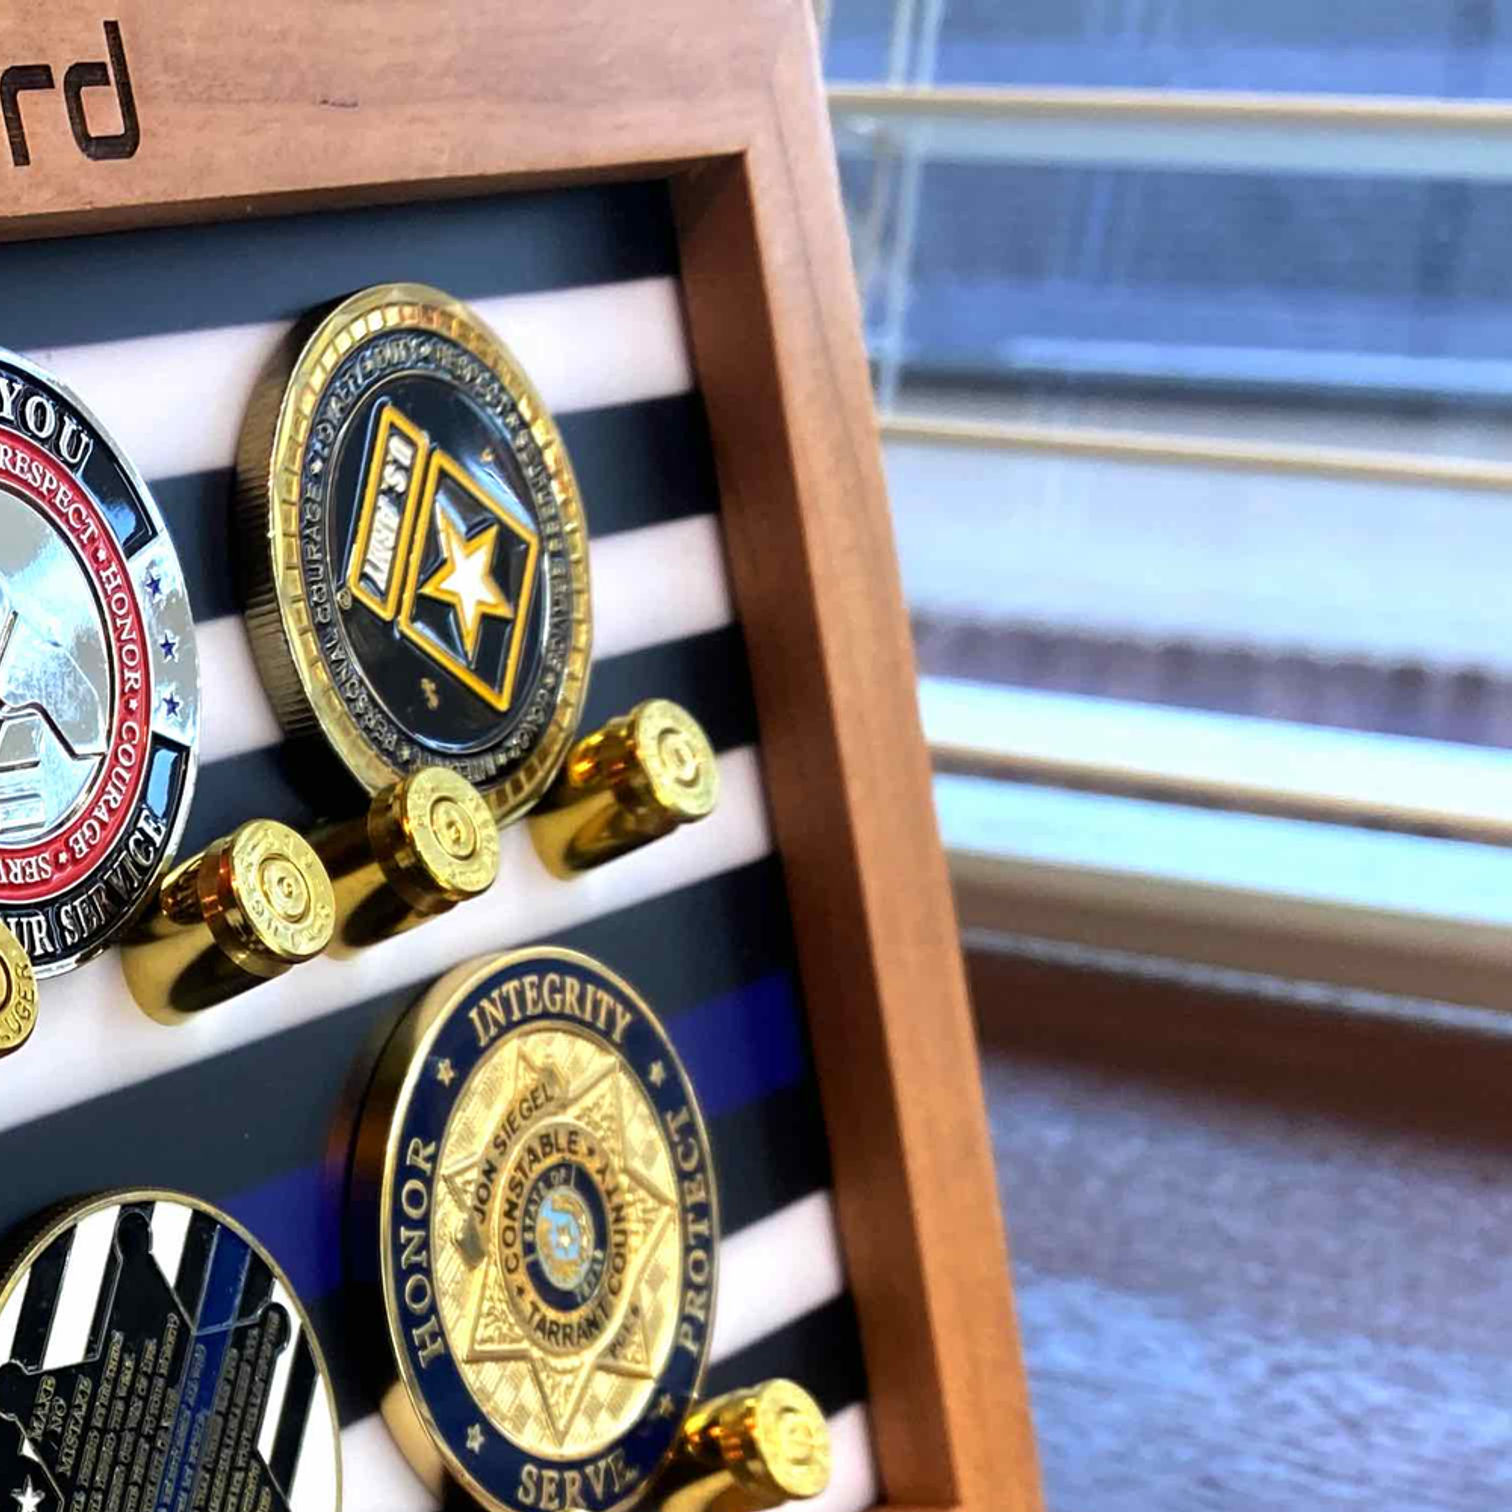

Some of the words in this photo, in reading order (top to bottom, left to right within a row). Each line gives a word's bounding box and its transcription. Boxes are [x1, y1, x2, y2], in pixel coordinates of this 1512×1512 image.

[99, 563, 142, 692] HONOR
[67, 721, 140, 859] COURAGE
[60, 807, 166, 946] SERVICE
[469, 973, 634, 1047] INTEGRITY
[473, 1161, 498, 1224] JON
[493, 1083, 554, 1157] SIEGEL
[503, 1130, 580, 1275] CONSTABLE
[399, 1137, 445, 1368] HONOR
[527, 1301, 611, 1346] TARRANT
[595, 1165, 627, 1297] COUNTY
[665, 1107, 711, 1357] PROTECT
[29, 1372, 57, 1443] MAKE
[48, 1395, 68, 1434] NO
[57, 1374, 93, 1478] MISTAKE
[517, 1449, 639, 1512] SERVE
